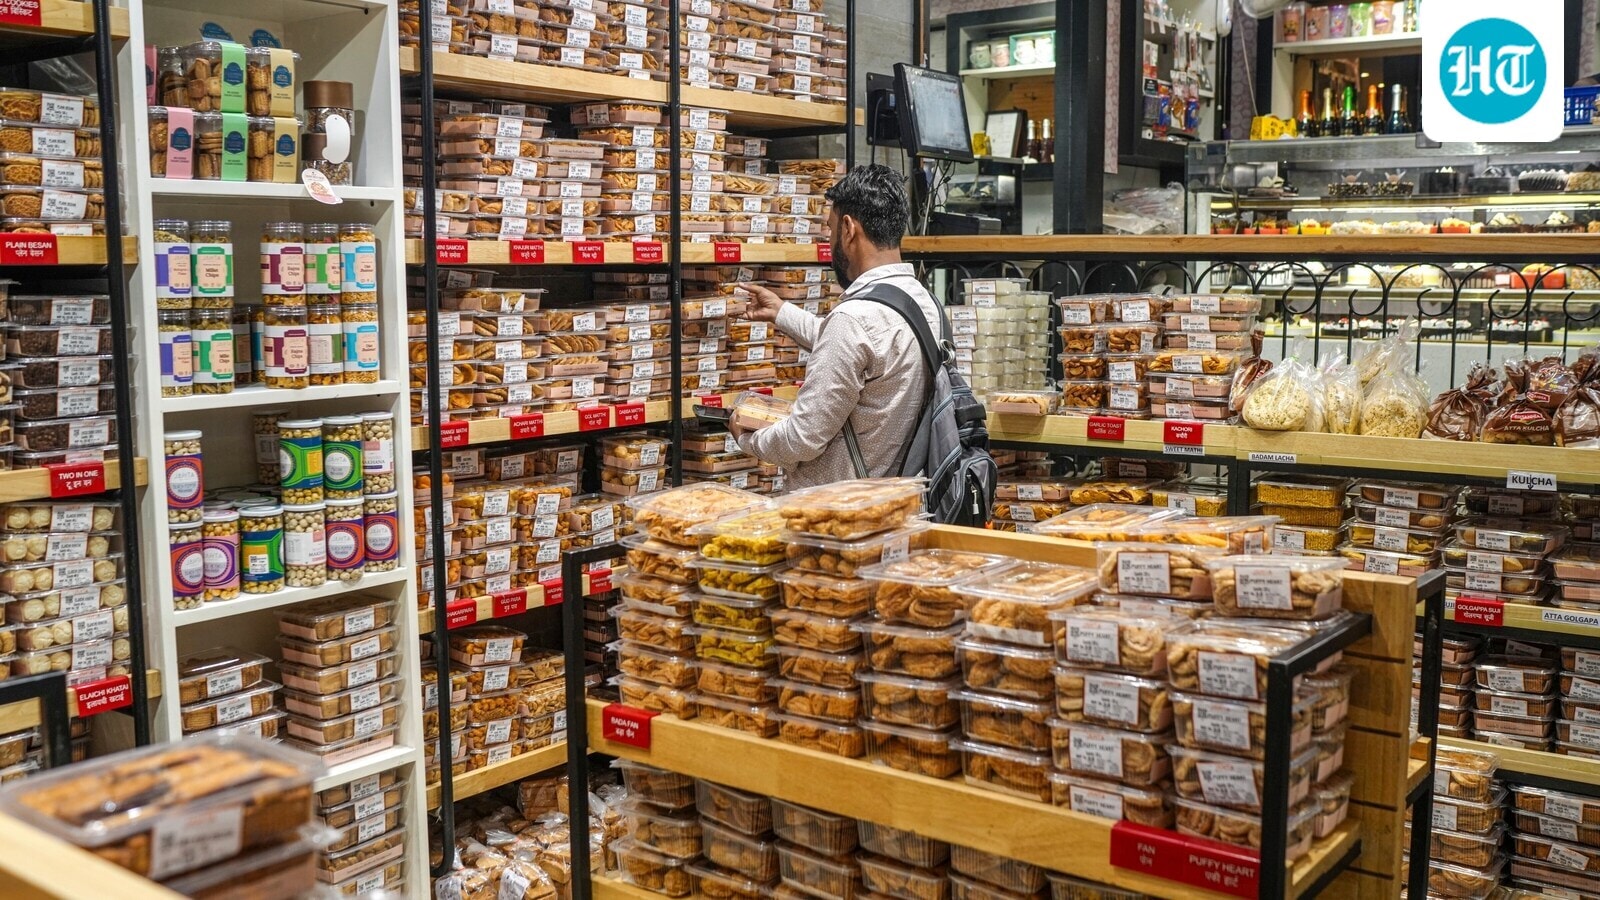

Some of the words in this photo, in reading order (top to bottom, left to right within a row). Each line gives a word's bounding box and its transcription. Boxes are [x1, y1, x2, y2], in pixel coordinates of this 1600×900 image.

[1511, 474, 1553, 486] KULCHA
[1457, 604, 1488, 613] GOLGAPPA
[1544, 612, 1563, 620] ATTA
[1564, 615, 1599, 625] GOLGAPA
[80, 690, 105, 701] ELAICHI
[106, 684, 129, 694] KHATAI
[611, 717, 627, 727] BADA
[627, 720, 639, 729] FAN
[1137, 842, 1156, 855] FAN
[1189, 854, 1220, 869] PUFFY
[1222, 861, 1255, 879] HEART
